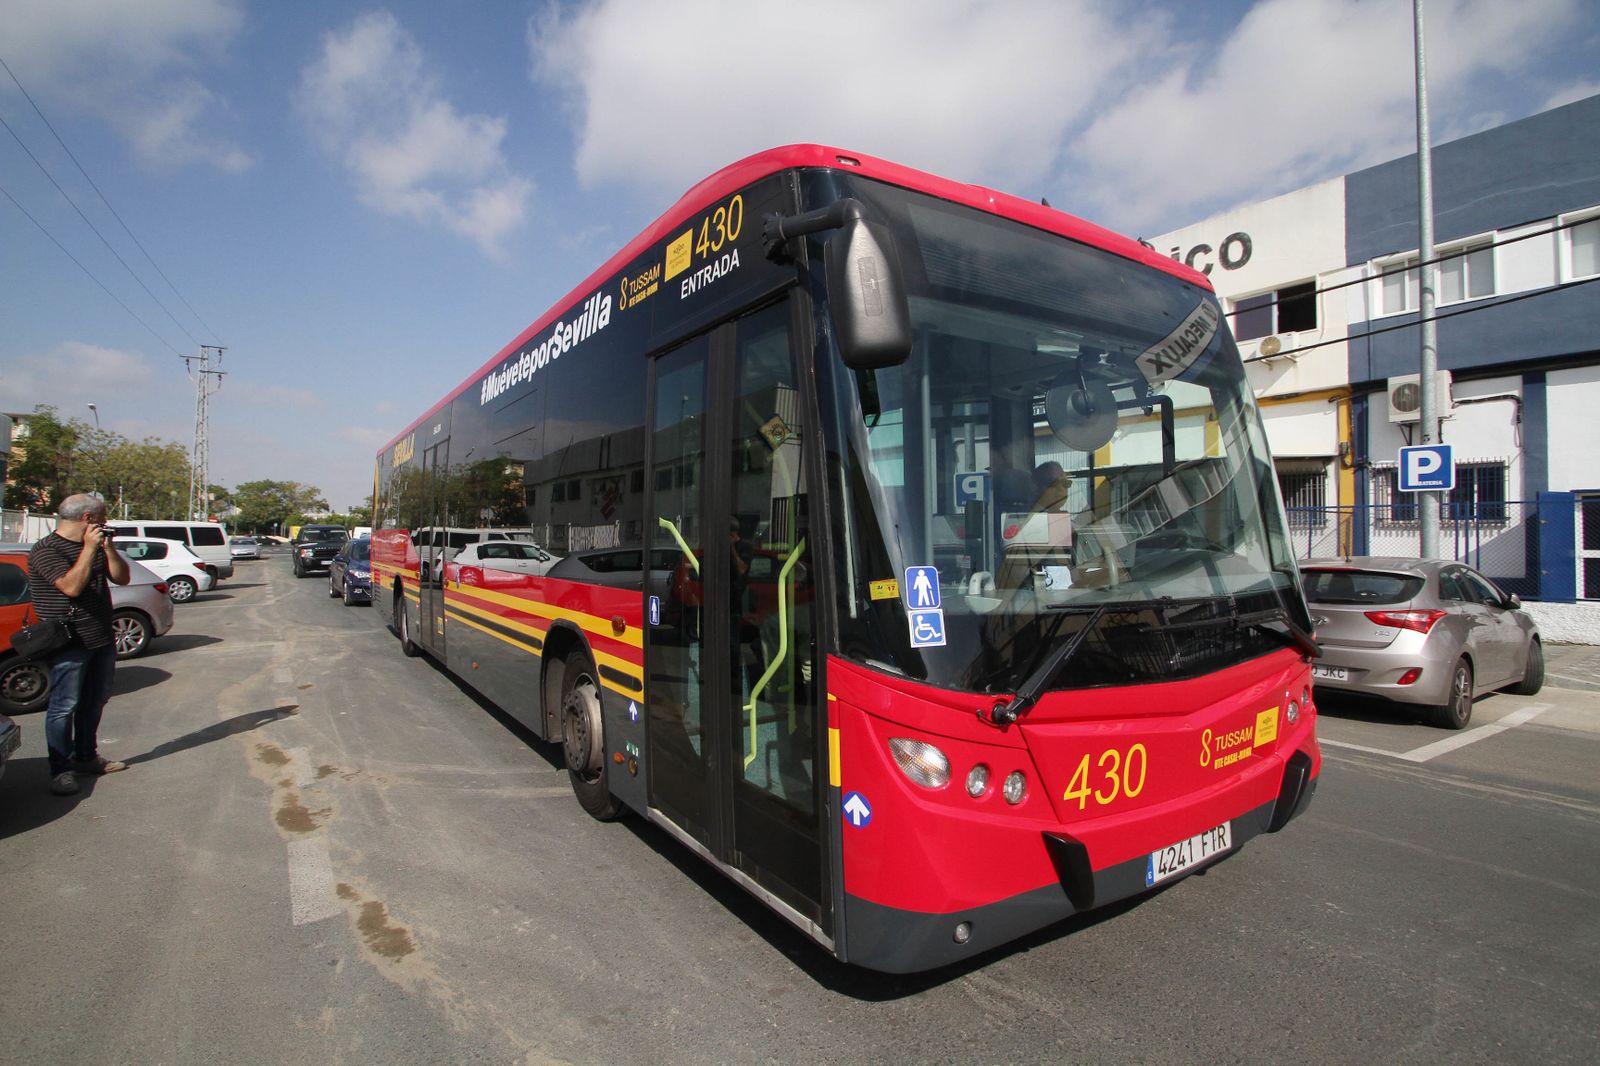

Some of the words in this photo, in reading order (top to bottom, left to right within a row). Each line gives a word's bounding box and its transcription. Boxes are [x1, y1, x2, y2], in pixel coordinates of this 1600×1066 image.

[695, 195, 743, 259] 430
[629, 263, 660, 296] TUSSAM
[680, 248, 740, 300] ENTRADA
[480, 291, 612, 407] #MuéveteporSevilla
[1408, 450, 1442, 486] P
[1321, 666, 1345, 679] JKC
[1215, 726, 1253, 752] TUSSAM
[1063, 743, 1147, 810] 430
[1158, 839, 1193, 876] 4241
[1201, 824, 1227, 857] FTR
